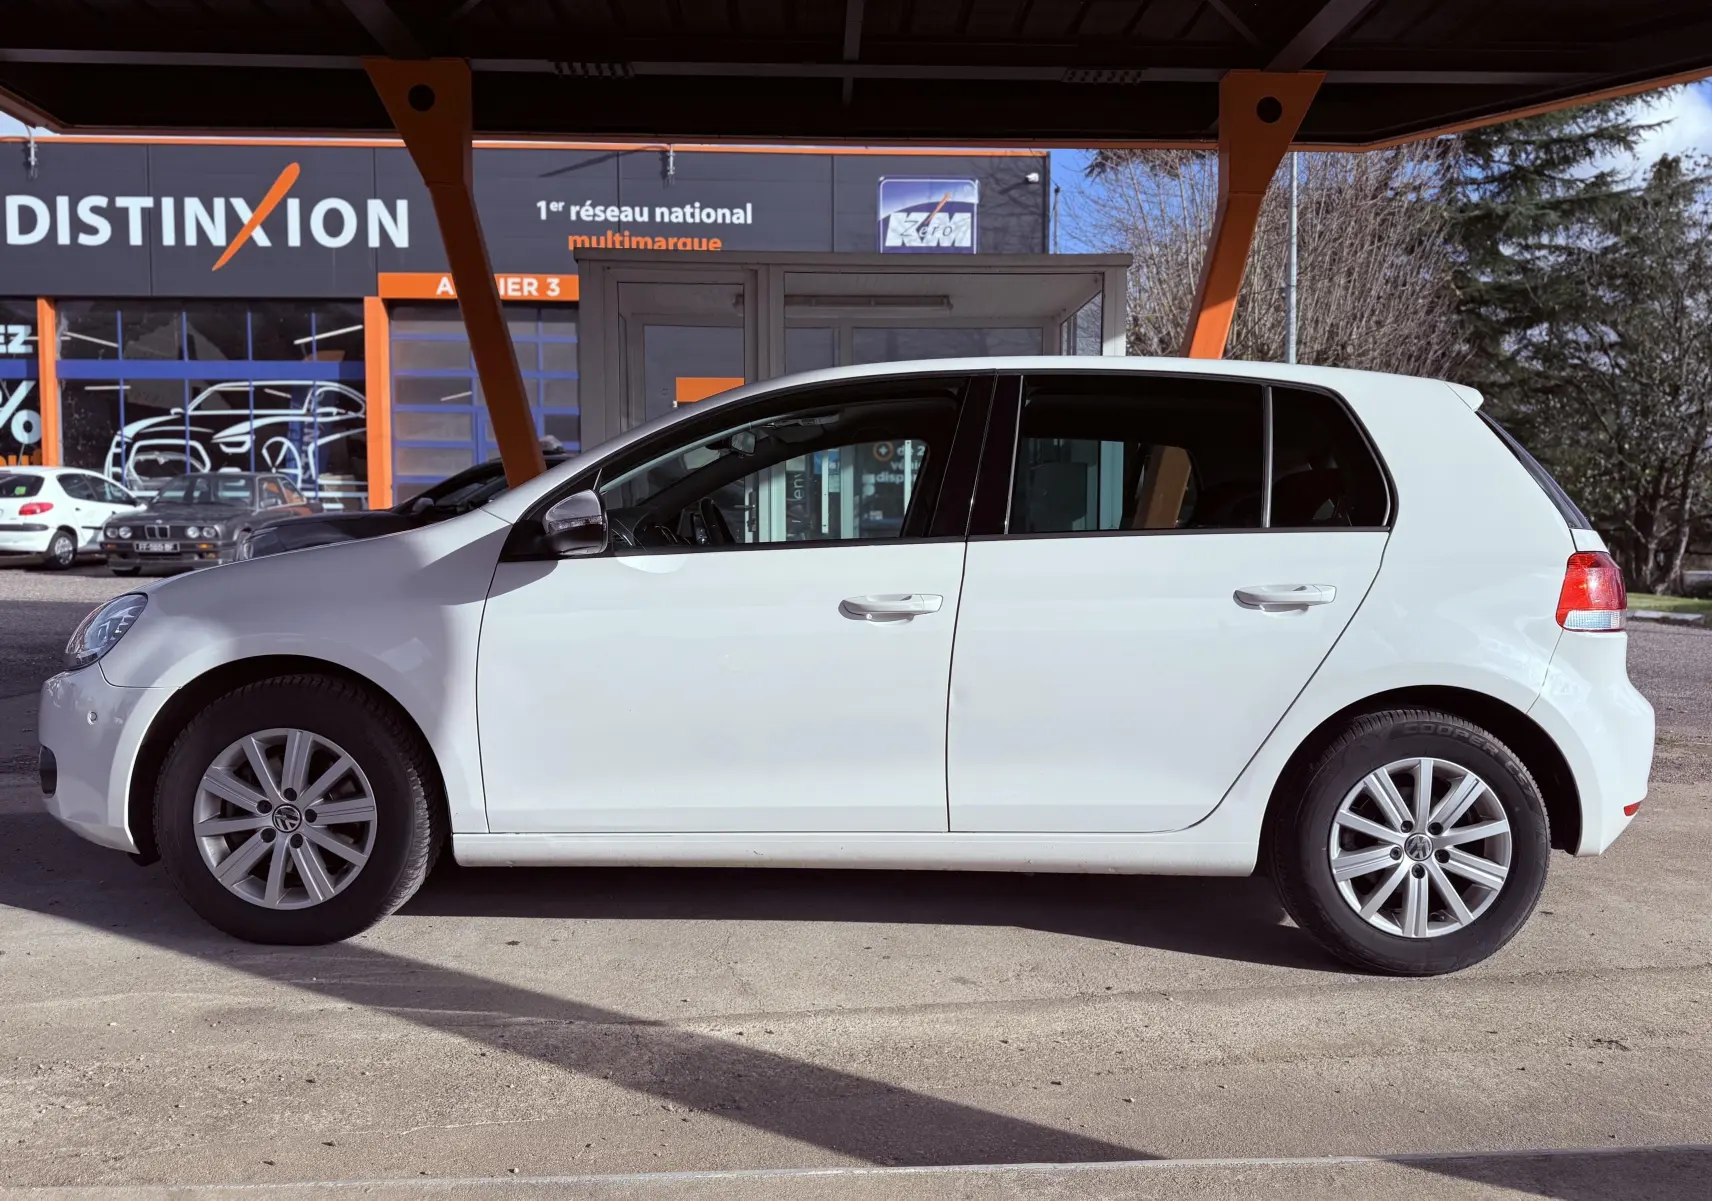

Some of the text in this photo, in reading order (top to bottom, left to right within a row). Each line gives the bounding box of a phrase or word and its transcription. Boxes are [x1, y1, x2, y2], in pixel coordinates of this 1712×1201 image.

[5, 163, 409, 271] DISTINXION
[570, 200, 649, 222] réseau
[655, 202, 752, 225] national
[568, 230, 722, 251] multimarque
[436, 276, 560, 297] AIER 3
[0, 324, 33, 354] Z
[1403, 722, 1500, 758] COOPER
